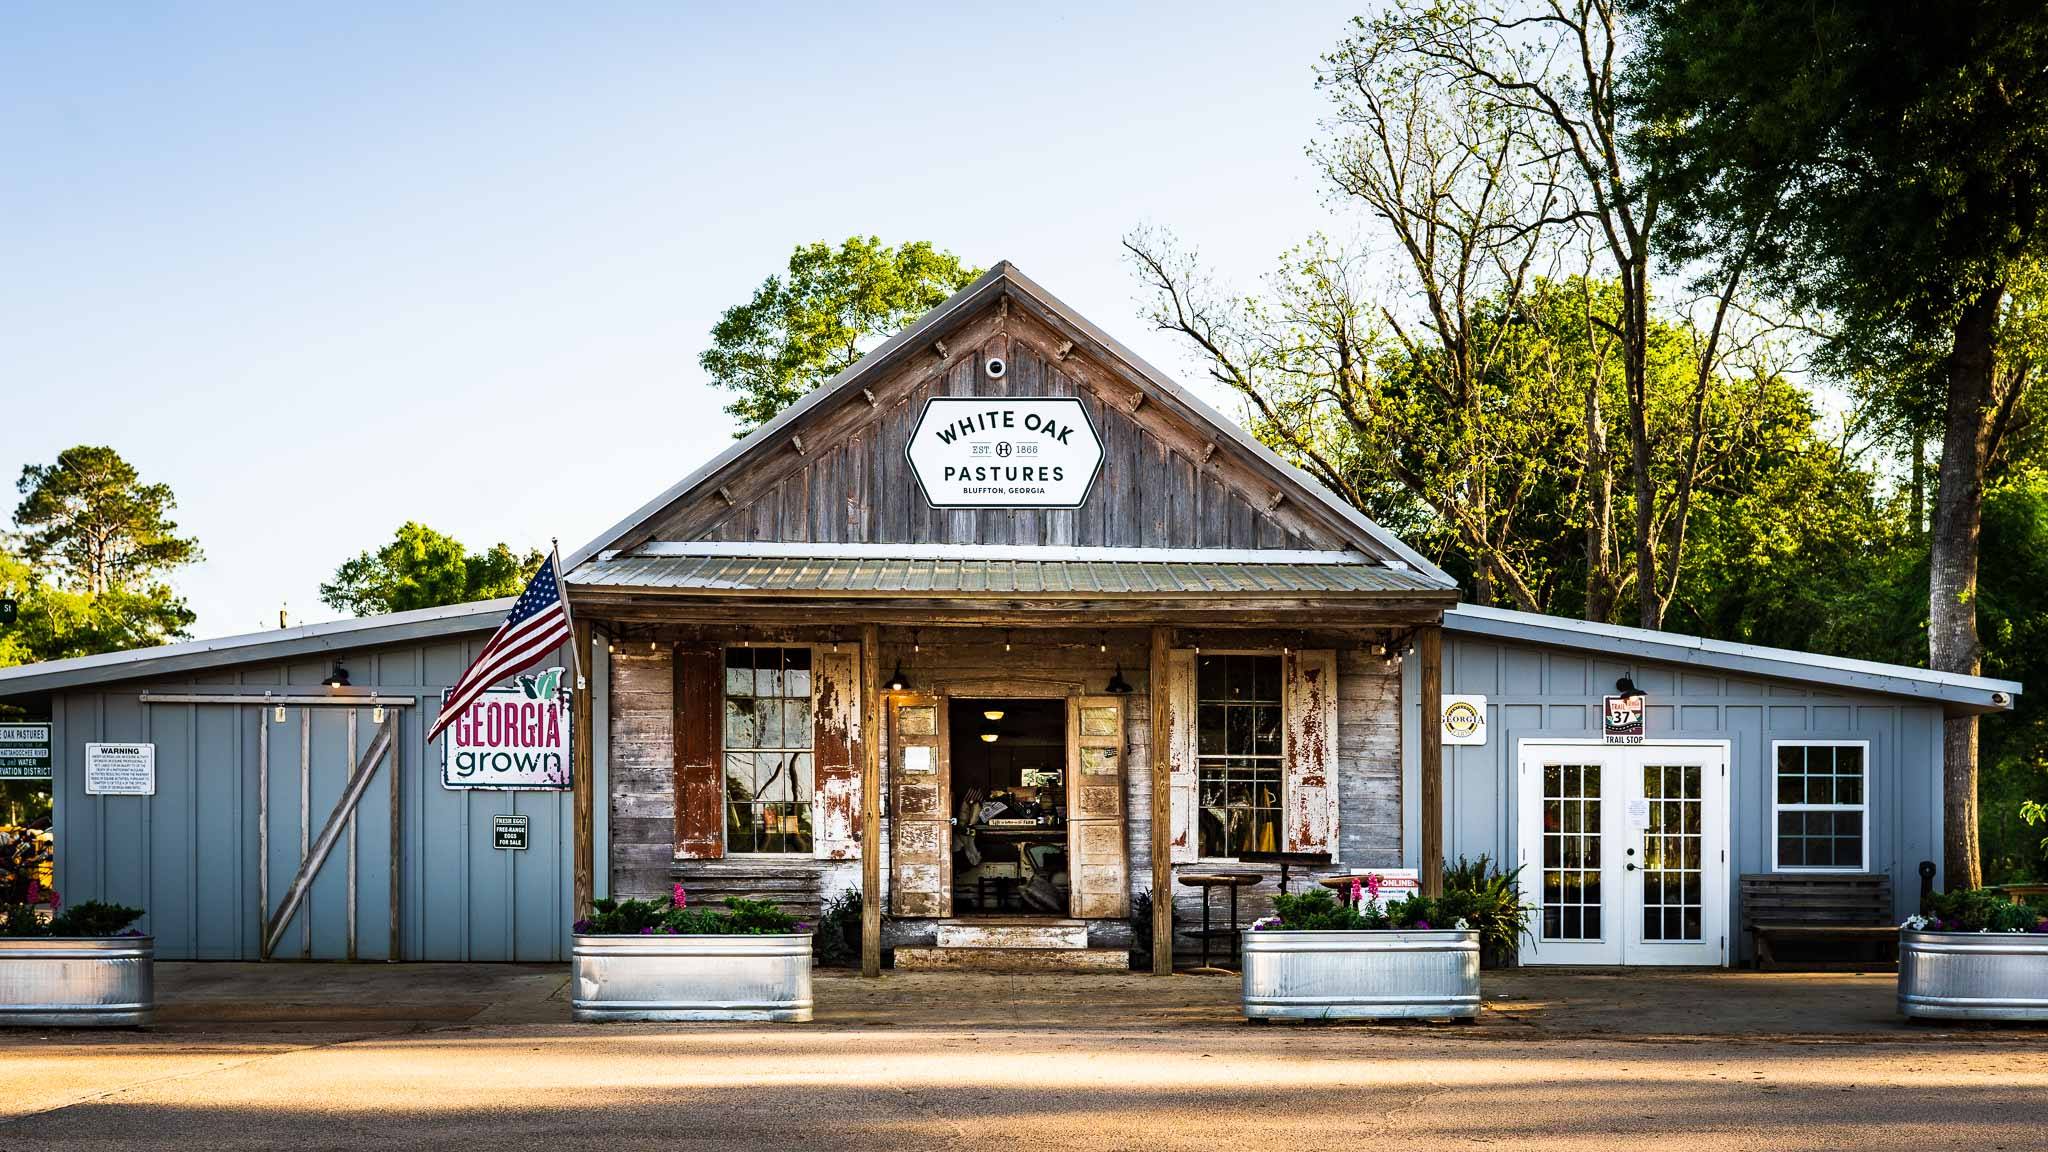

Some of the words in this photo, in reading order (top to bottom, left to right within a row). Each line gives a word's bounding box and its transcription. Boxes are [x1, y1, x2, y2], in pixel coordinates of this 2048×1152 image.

[936, 411, 1014, 445] WHITE
[1025, 413, 1074, 445] OAK
[972, 446, 992, 454] EST.
[1016, 446, 1038, 454] 1866
[945, 467, 1063, 481] PASTURES
[1614, 711, 1630, 723] 37
[456, 702, 561, 747] GEORGIA
[3, 730, 14, 739] OAK
[16, 730, 44, 739] PASTURES
[456, 752, 561, 777] grown
[24, 767, 51, 776] DISTRICT
